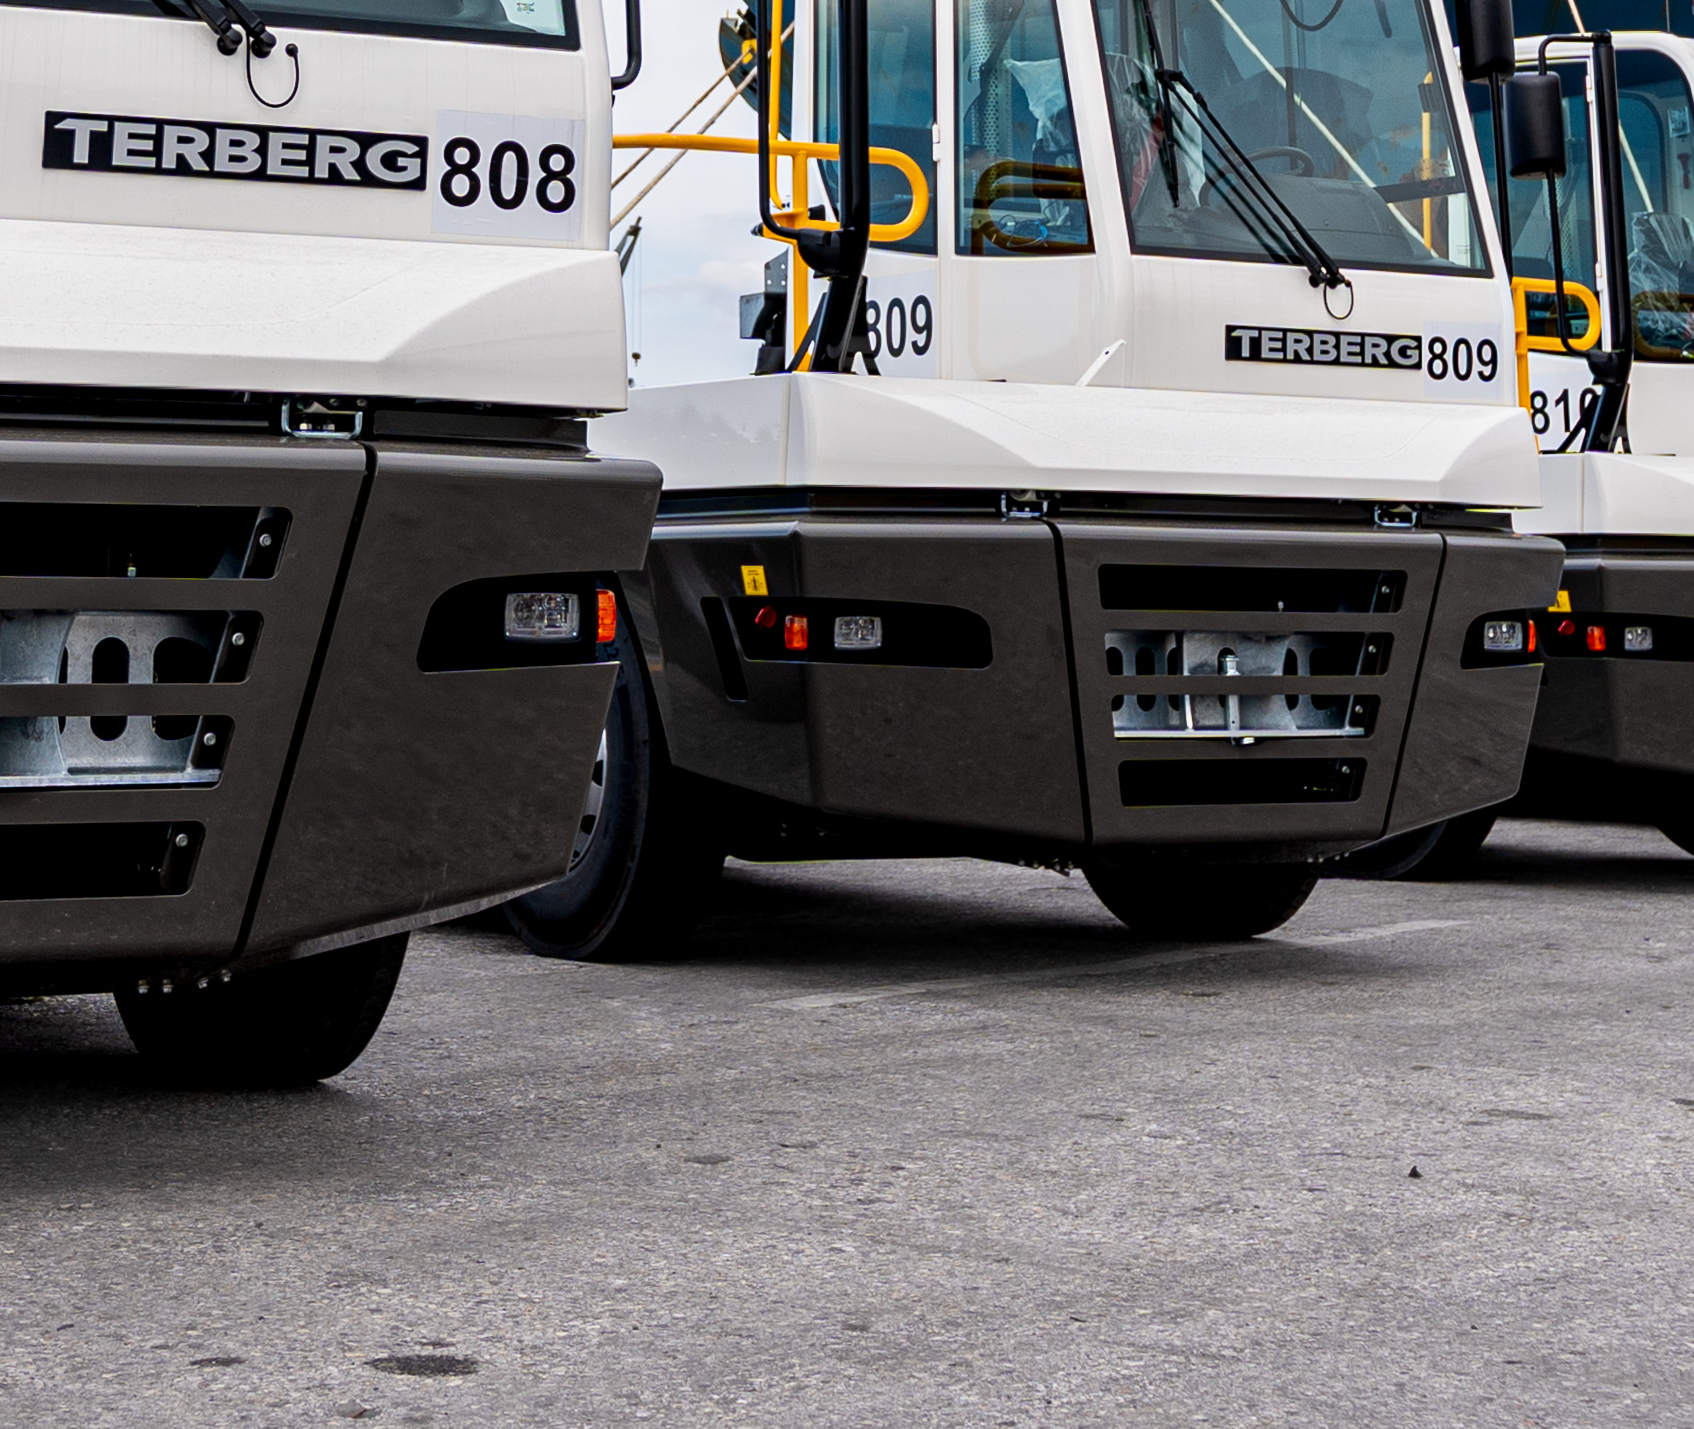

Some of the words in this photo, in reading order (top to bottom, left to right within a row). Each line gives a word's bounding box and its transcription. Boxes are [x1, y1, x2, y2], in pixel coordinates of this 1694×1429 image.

[53, 117, 423, 183] TERBERG
[439, 136, 577, 213] 808
[866, 294, 933, 358] 809
[1230, 328, 1420, 366] TERBERG
[1426, 336, 1499, 382] 809
